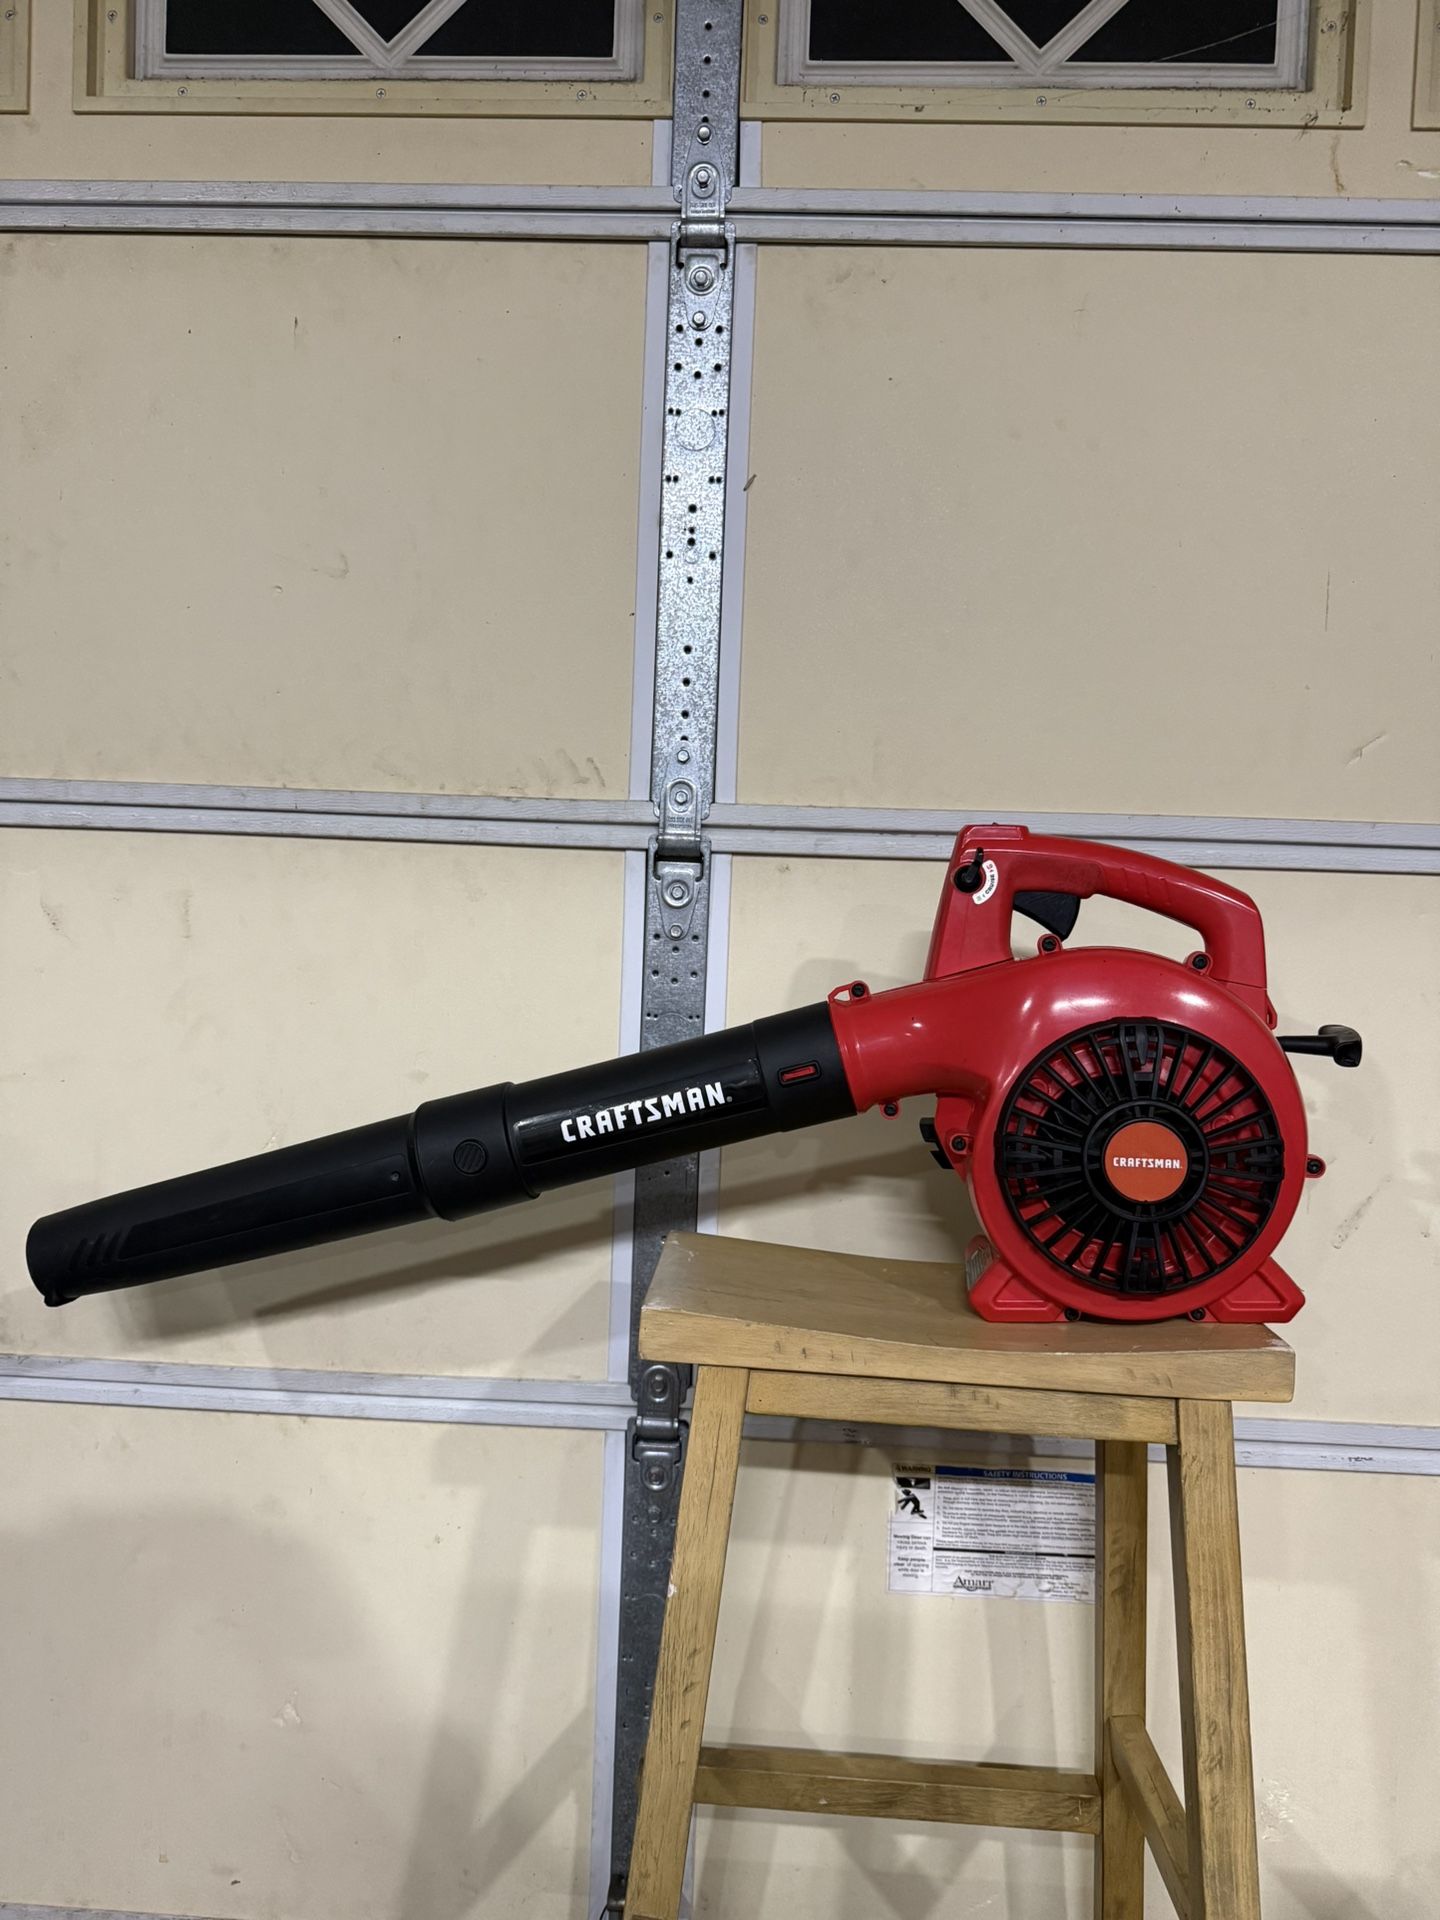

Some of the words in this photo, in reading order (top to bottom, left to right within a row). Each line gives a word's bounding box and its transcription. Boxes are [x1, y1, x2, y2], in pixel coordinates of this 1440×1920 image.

[560, 1082, 726, 1143] CRAFTSMAN
[1113, 1157, 1181, 1169] CRAFTSMAN
[983, 1470, 1010, 1479] SAFETY
[1012, 1471, 1068, 1481] INSTRUCTIONS
[953, 1575, 994, 1591] Amarr
